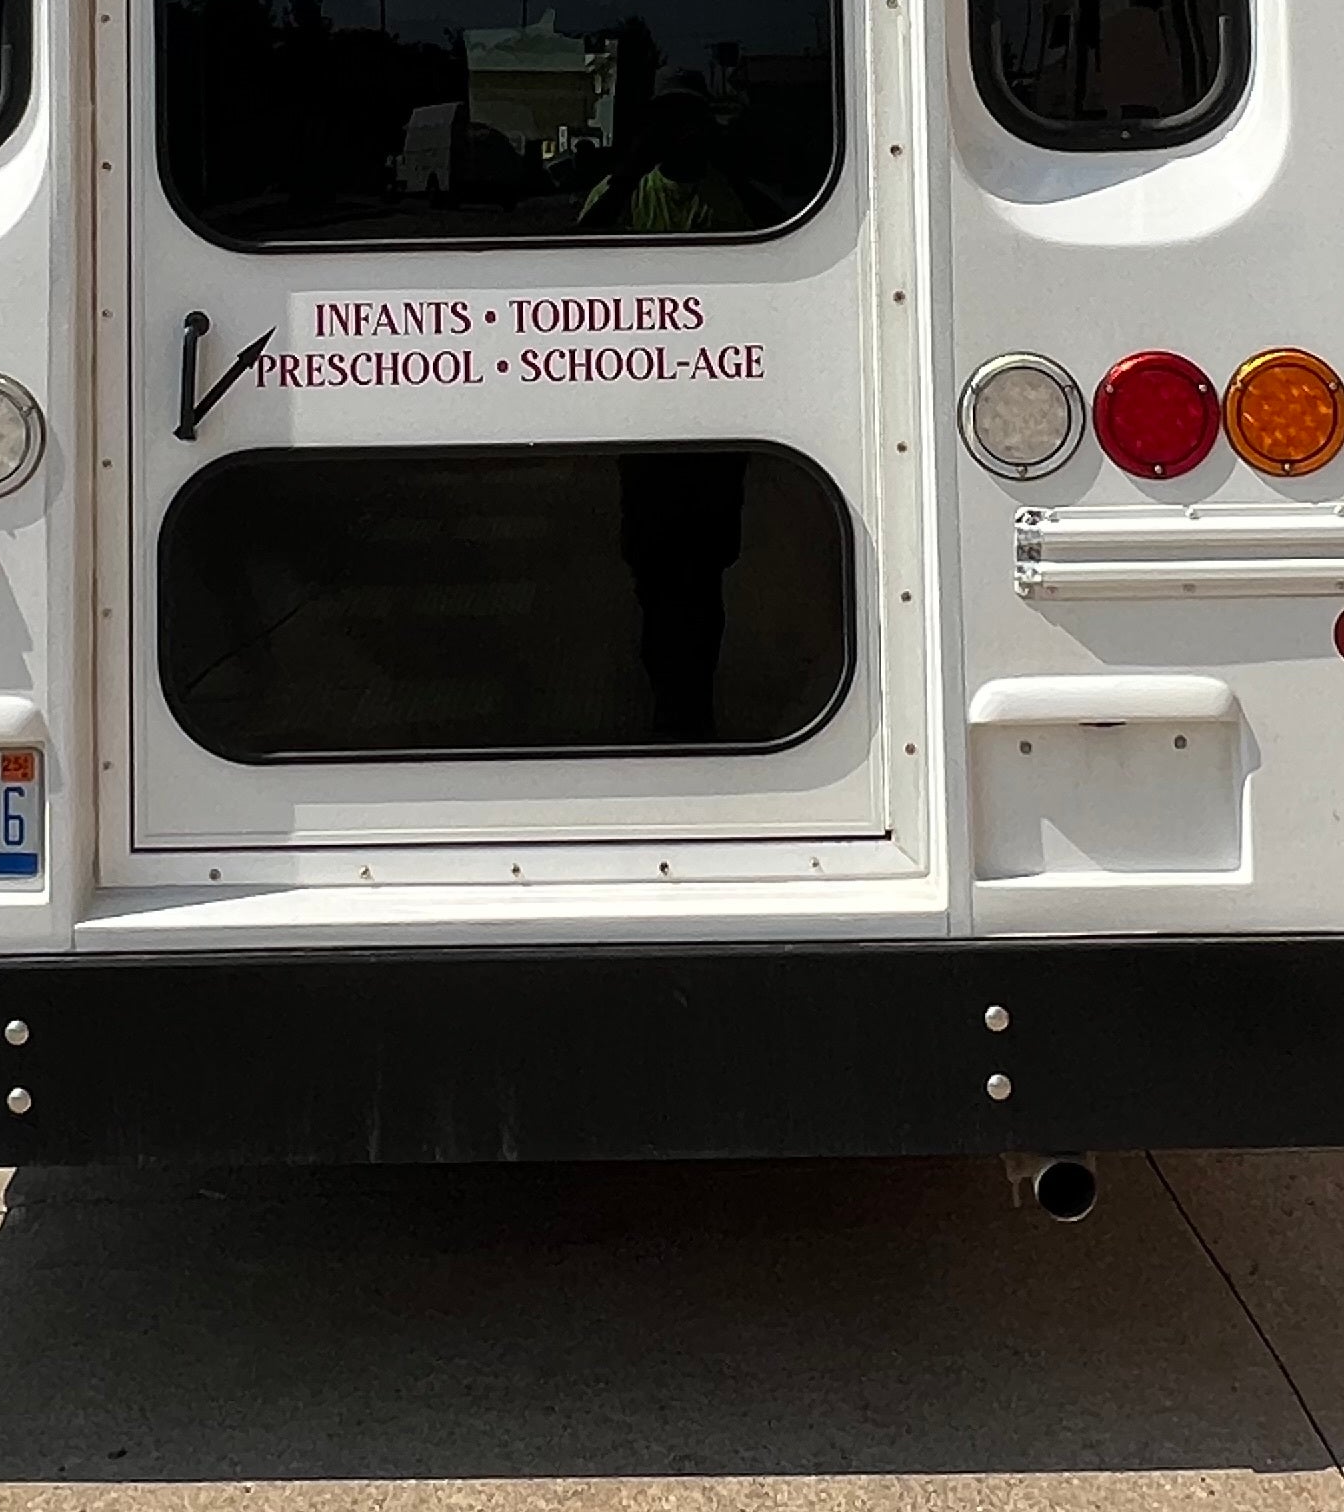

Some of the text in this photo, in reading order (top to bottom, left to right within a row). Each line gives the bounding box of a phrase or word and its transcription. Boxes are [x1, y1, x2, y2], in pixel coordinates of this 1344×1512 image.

[314, 297, 705, 337] INFANTS TODDLERS
[256, 345, 764, 387] PRESCHOOL SCHOOL-AGE
